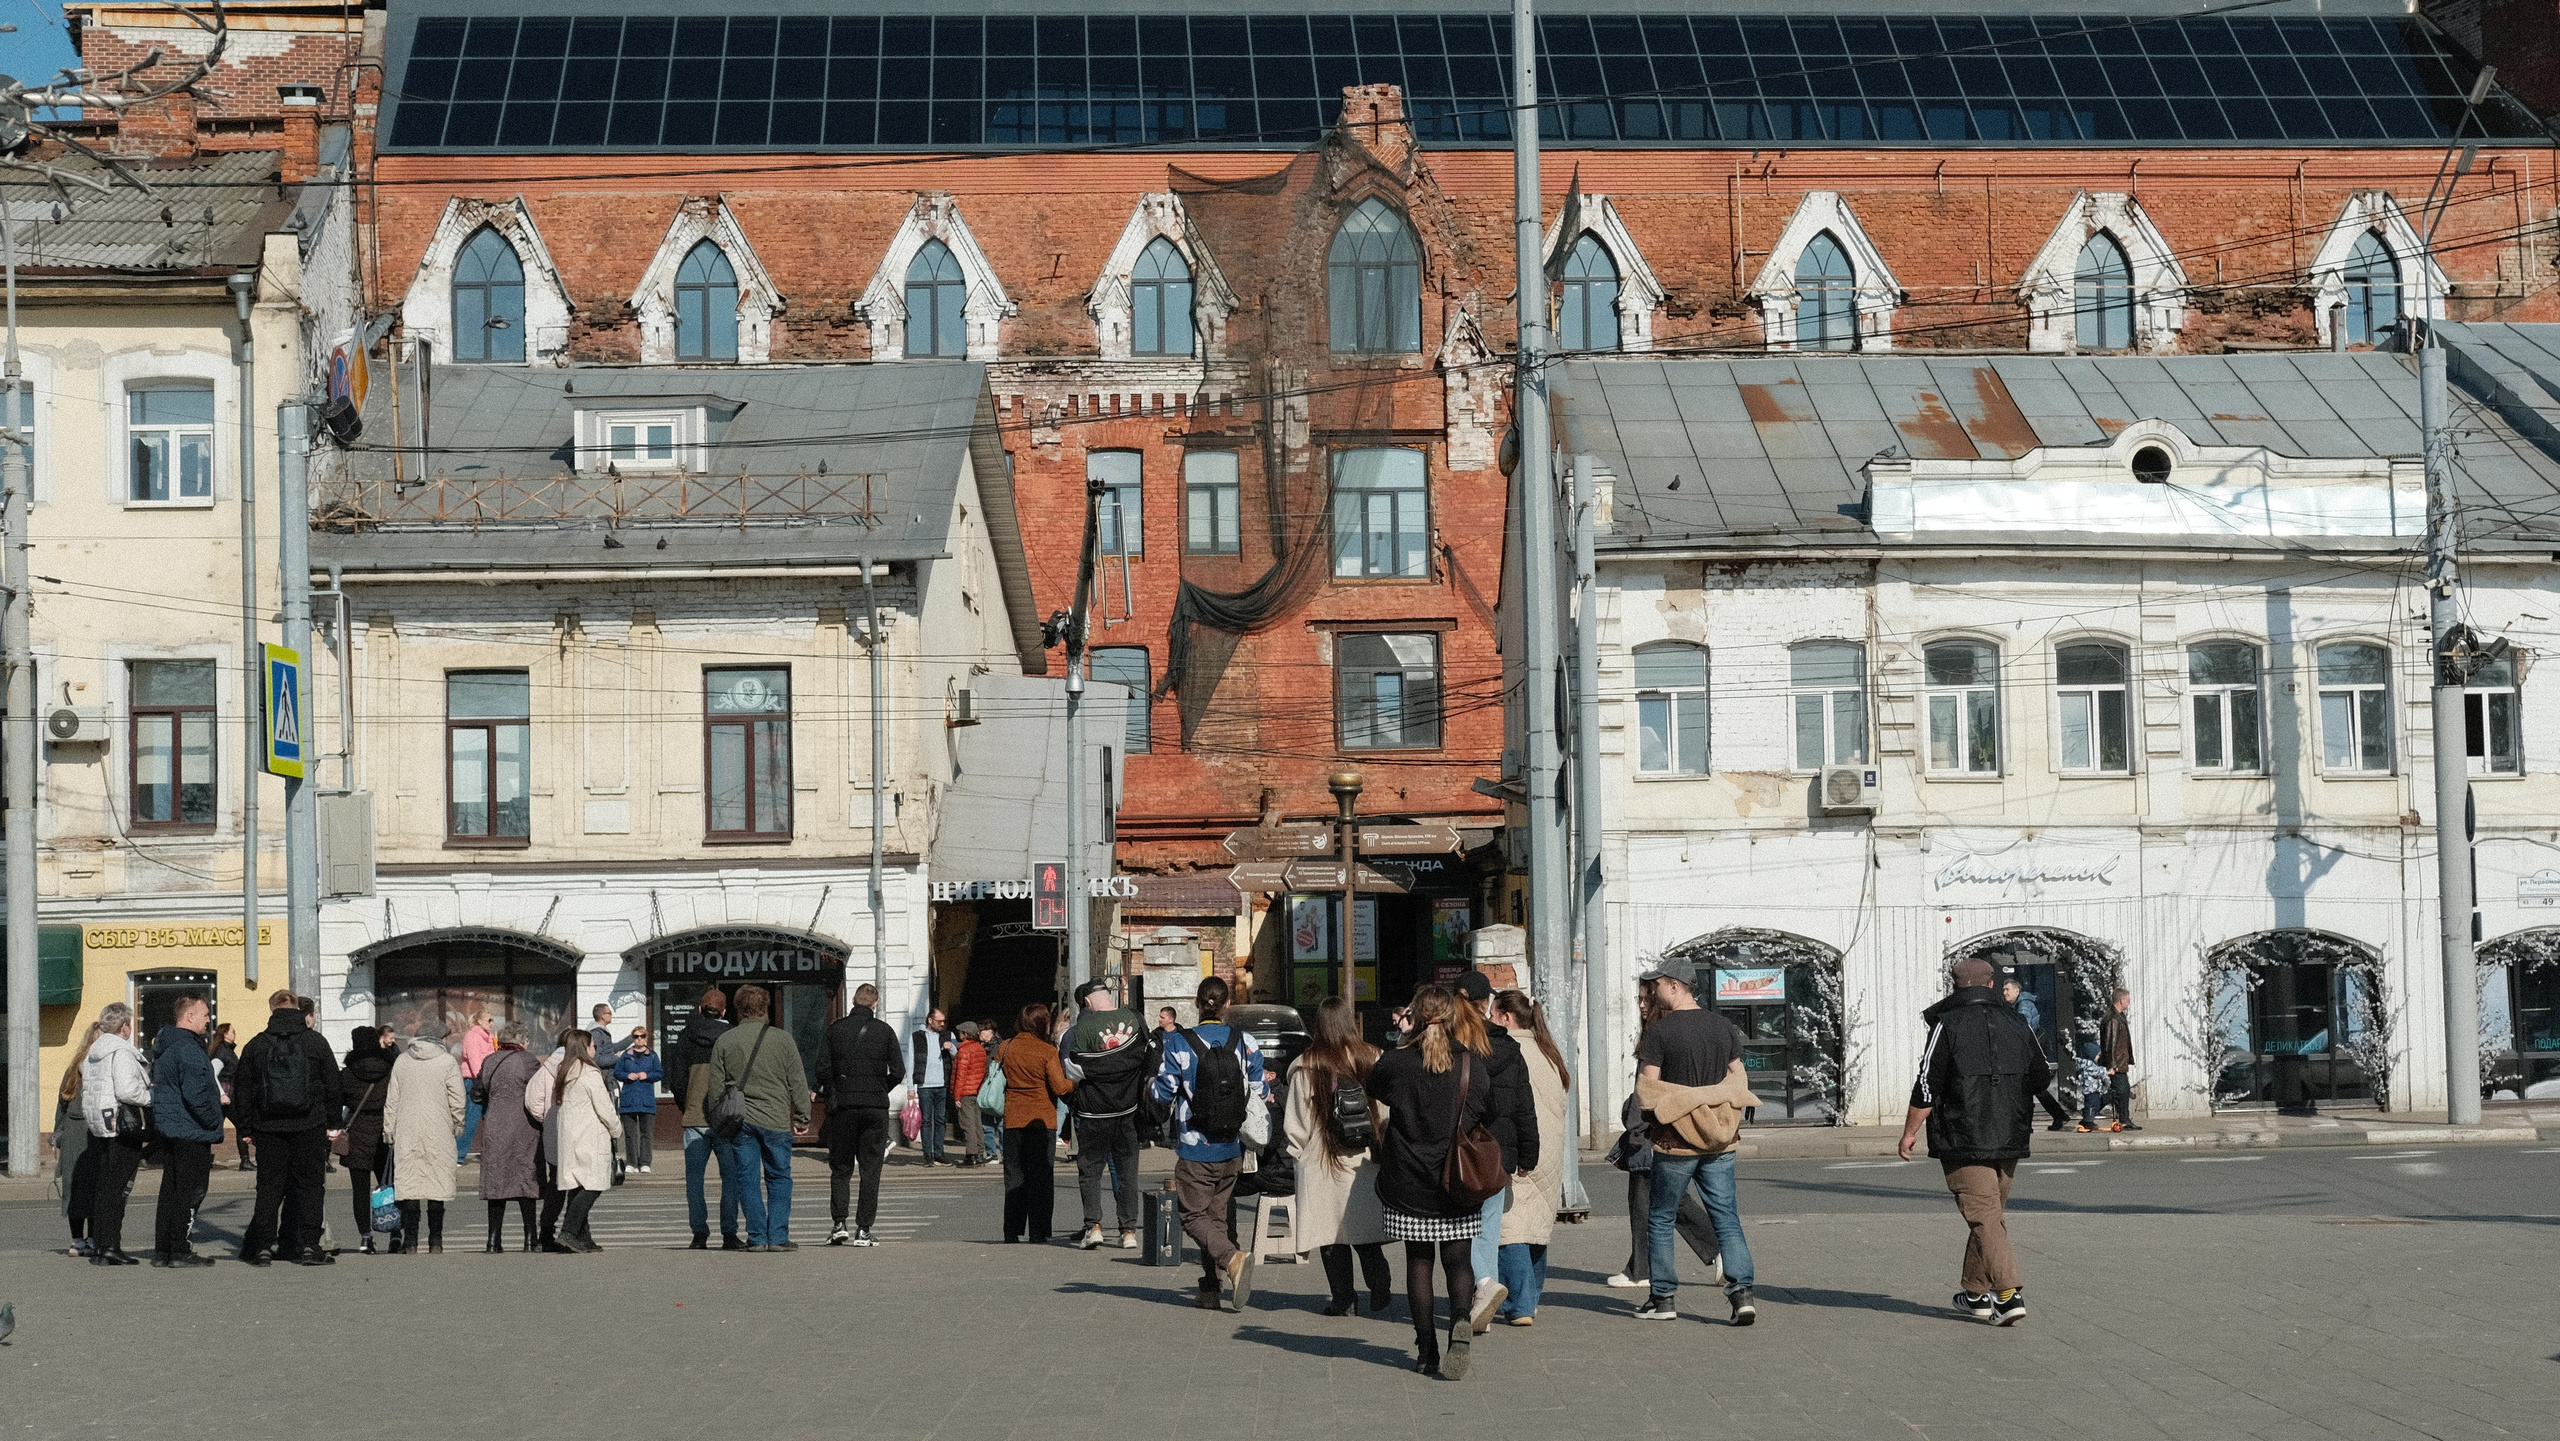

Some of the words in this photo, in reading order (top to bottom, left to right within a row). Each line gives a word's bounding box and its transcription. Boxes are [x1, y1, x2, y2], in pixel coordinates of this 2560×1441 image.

[931, 876, 1139, 904] ЦИРЮЛИКЪ
[1039, 898, 1064, 926] 04
[86, 928, 140, 948] СЫР
[145, 928, 178, 947] ВЪ
[666, 951, 821, 977] ПРОДУКТЫ
[1741, 1057, 1767, 1068] УФЕТ
